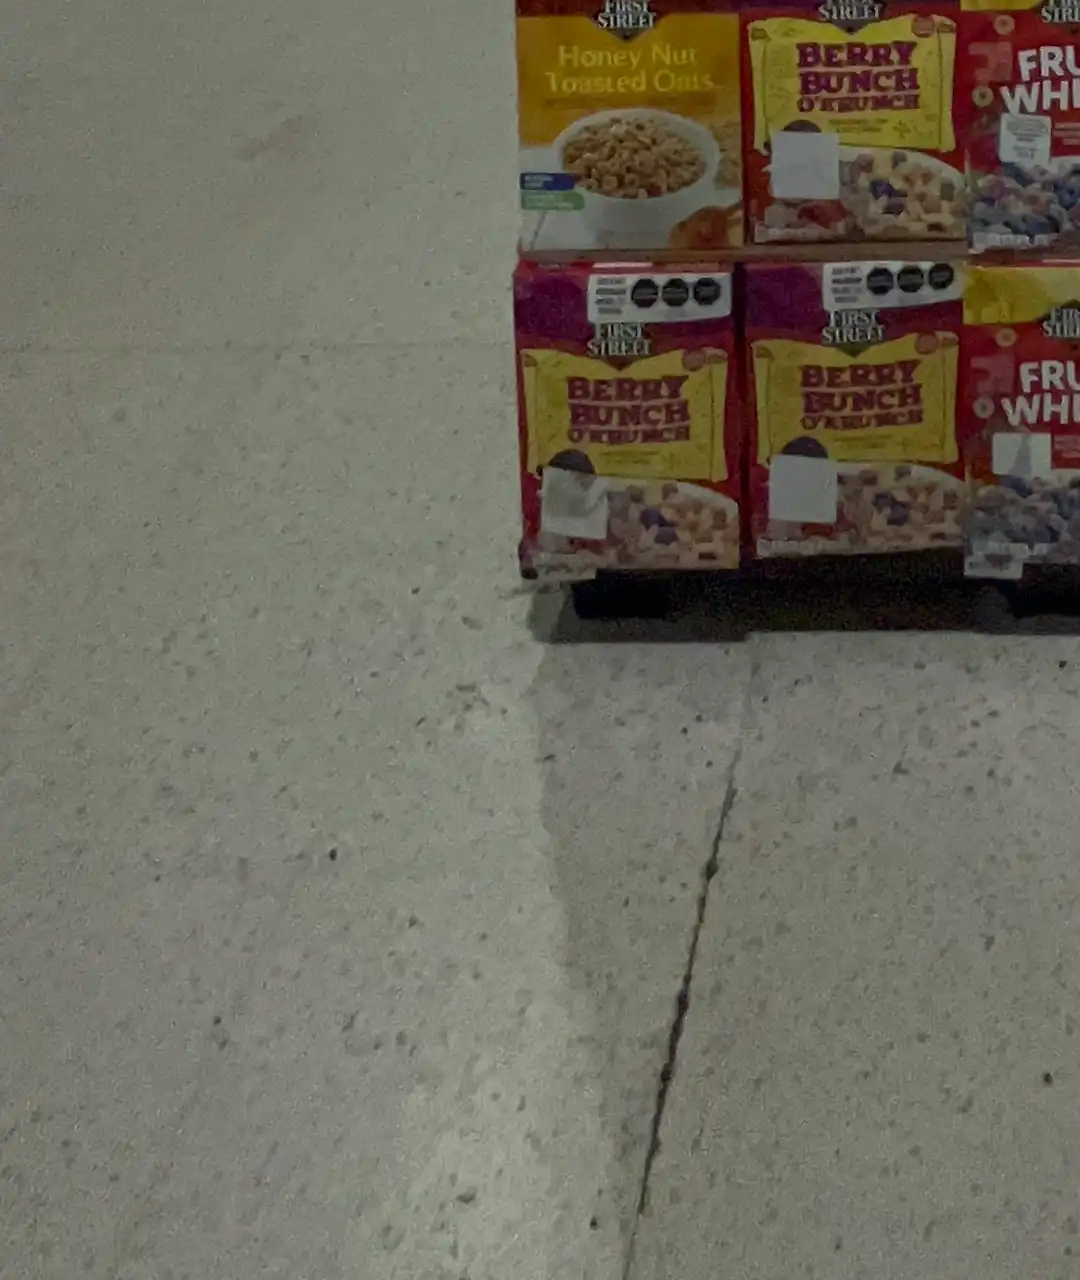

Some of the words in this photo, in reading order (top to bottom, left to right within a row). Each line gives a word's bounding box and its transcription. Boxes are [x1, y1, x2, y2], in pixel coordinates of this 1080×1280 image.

[558, 45, 642, 70] Honey
[652, 44, 697, 66] Nut
[797, 42, 917, 67] BERRY
[544, 71, 647, 95] Toasted
[654, 71, 714, 90] Oats
[800, 67, 919, 95] BUNCH
[801, 360, 921, 388] BERRY
[567, 375, 690, 401] BERRY
[803, 384, 923, 417] BUNCH
[570, 400, 690, 426] BUNCH
